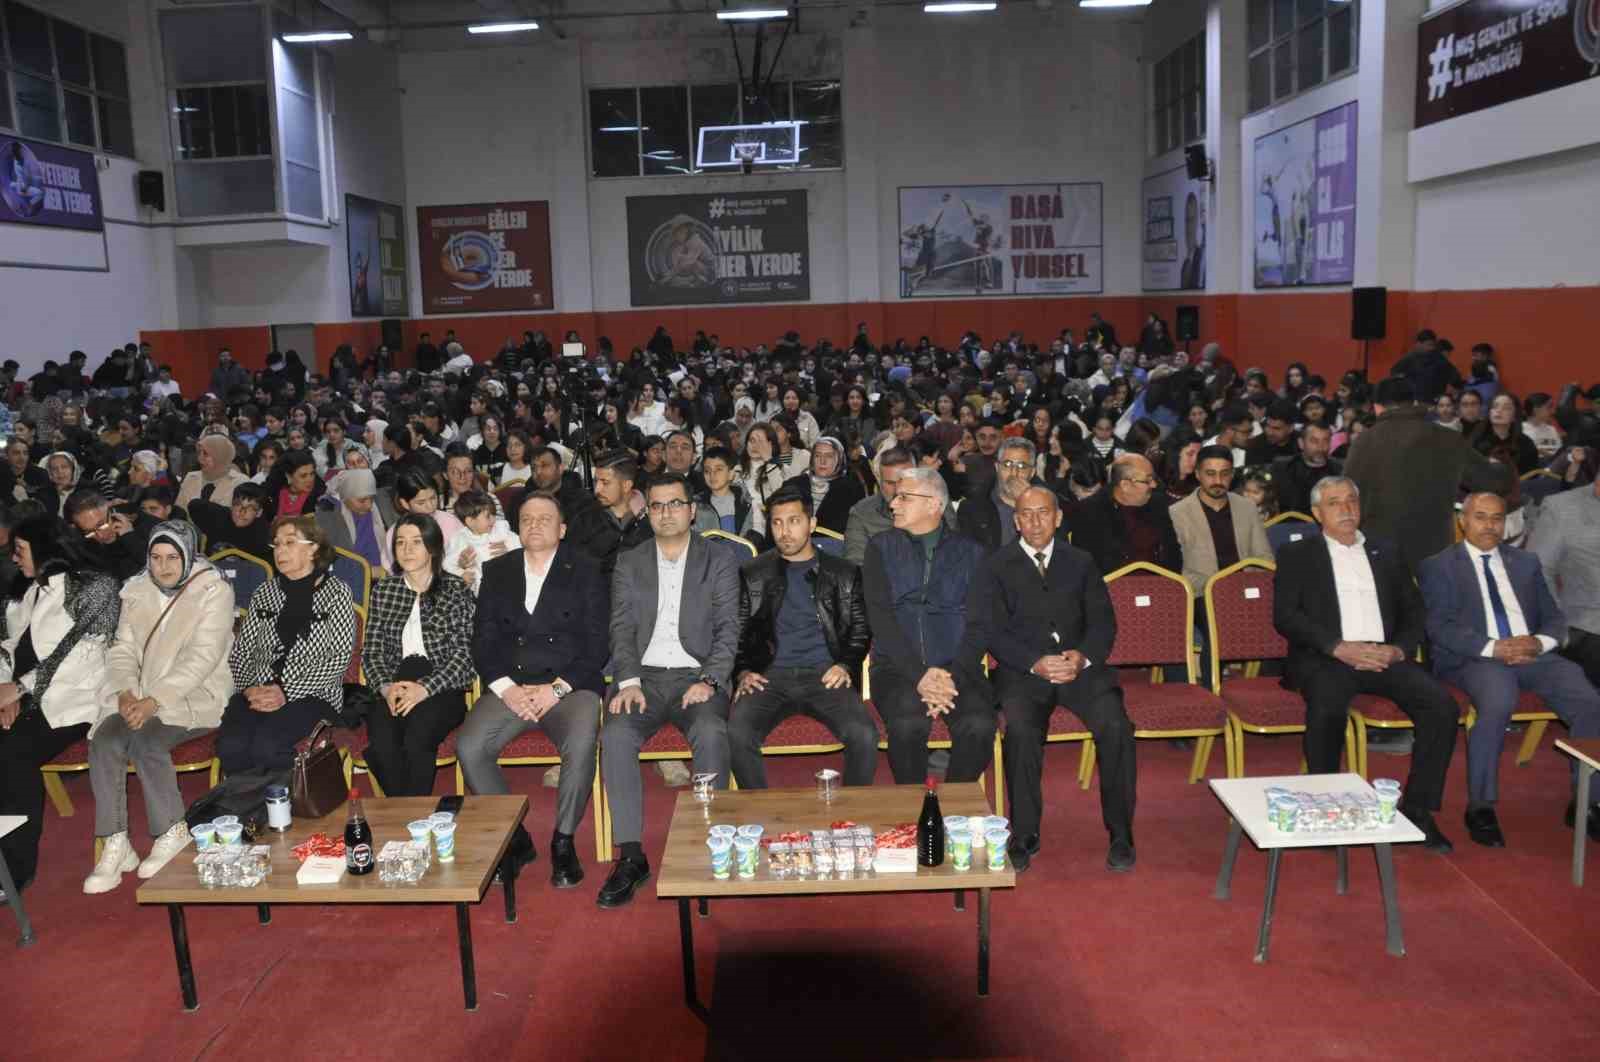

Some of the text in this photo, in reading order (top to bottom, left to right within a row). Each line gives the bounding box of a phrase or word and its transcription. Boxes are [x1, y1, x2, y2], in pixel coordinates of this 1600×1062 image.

[1477, 16, 1519, 48] GENÇLİK
[1521, 8, 1534, 31] VE
[64, 191, 94, 214] YERDE
[750, 252, 801, 276] YERDE
[1010, 252, 1089, 279] YÜKSEL
[495, 269, 533, 288] YERDE
